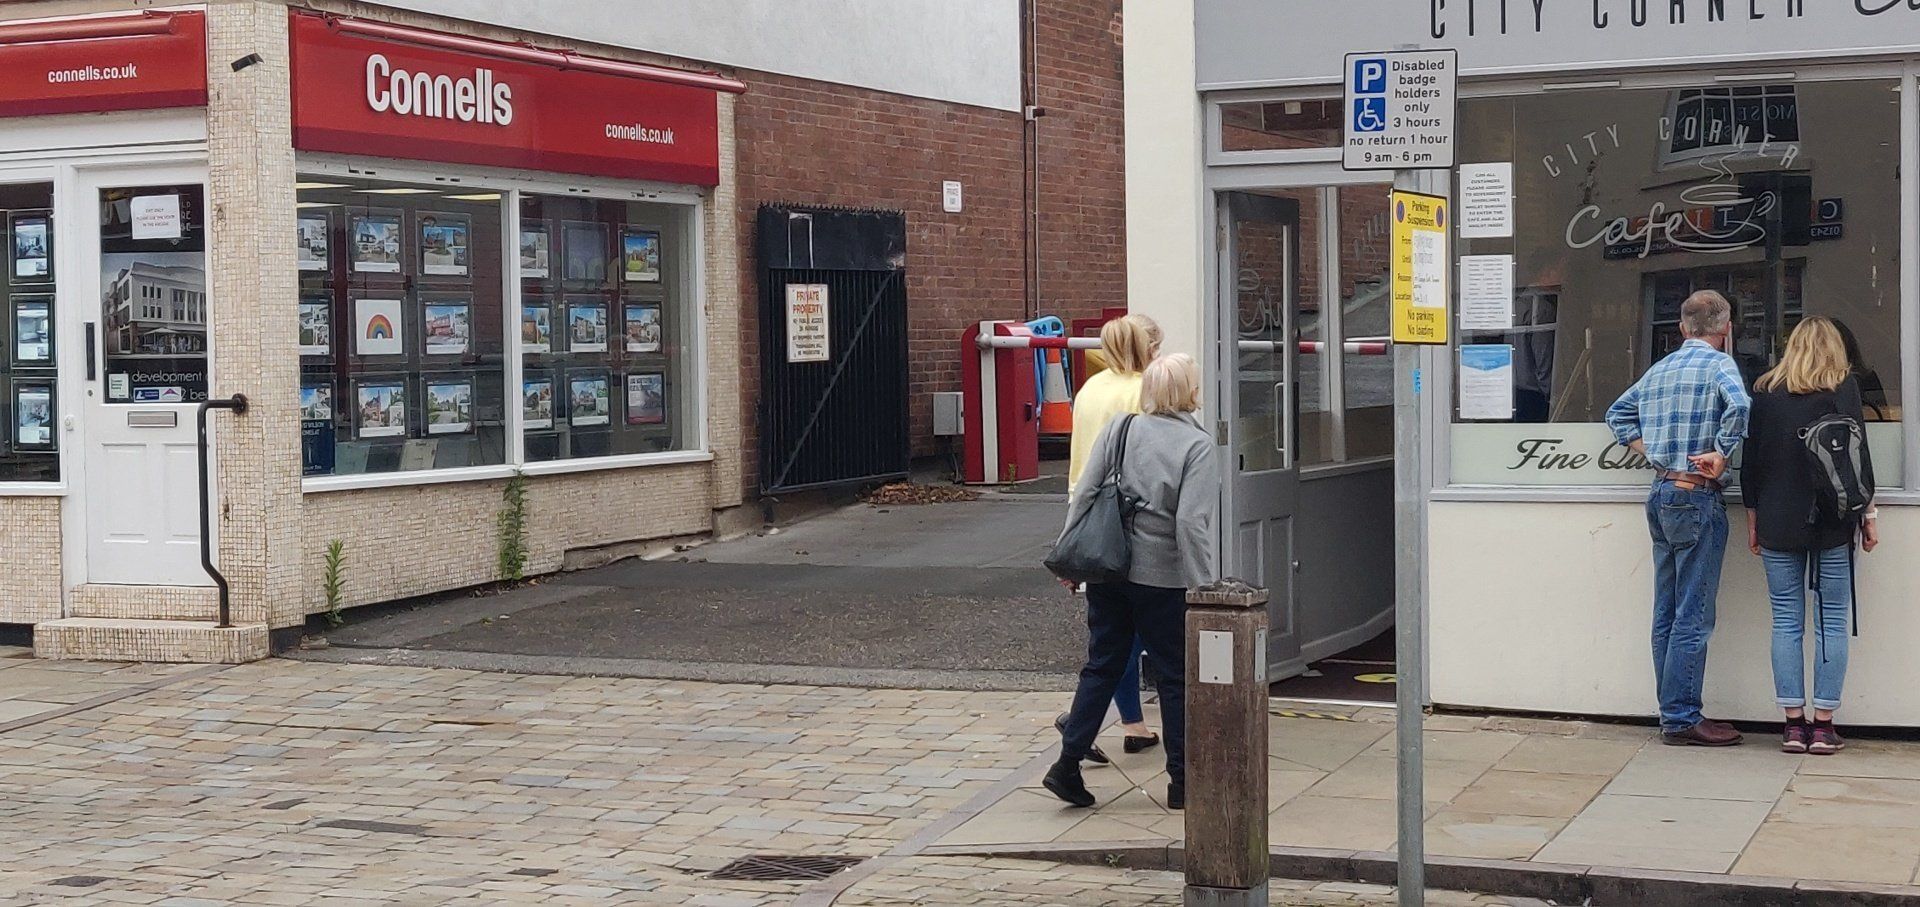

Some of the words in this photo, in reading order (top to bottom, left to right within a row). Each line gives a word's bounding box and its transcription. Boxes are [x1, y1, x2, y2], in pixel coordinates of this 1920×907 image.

[1392, 60, 1445, 71] Disabled
[48, 63, 137, 83] connells.co.uk
[1400, 75, 1436, 86] badge
[366, 53, 512, 126] Connells
[1395, 88, 1440, 98] holders
[1404, 101, 1430, 113] only
[1393, 117, 1401, 127] 3
[1406, 117, 1441, 127] hours
[605, 123, 674, 145] connells.co.uk
[1349, 137, 1364, 146] no
[1368, 135, 1406, 145] return
[1411, 134, 1416, 144] 1
[1420, 133, 1448, 144] hour
[1542, 124, 1620, 178] CITY
[1658, 117, 1798, 169] CORNER
[1402, 151, 1410, 161] 6
[1413, 153, 1432, 163] pm
[132, 370, 202, 384] development
[1507, 439, 1592, 470] Fine
